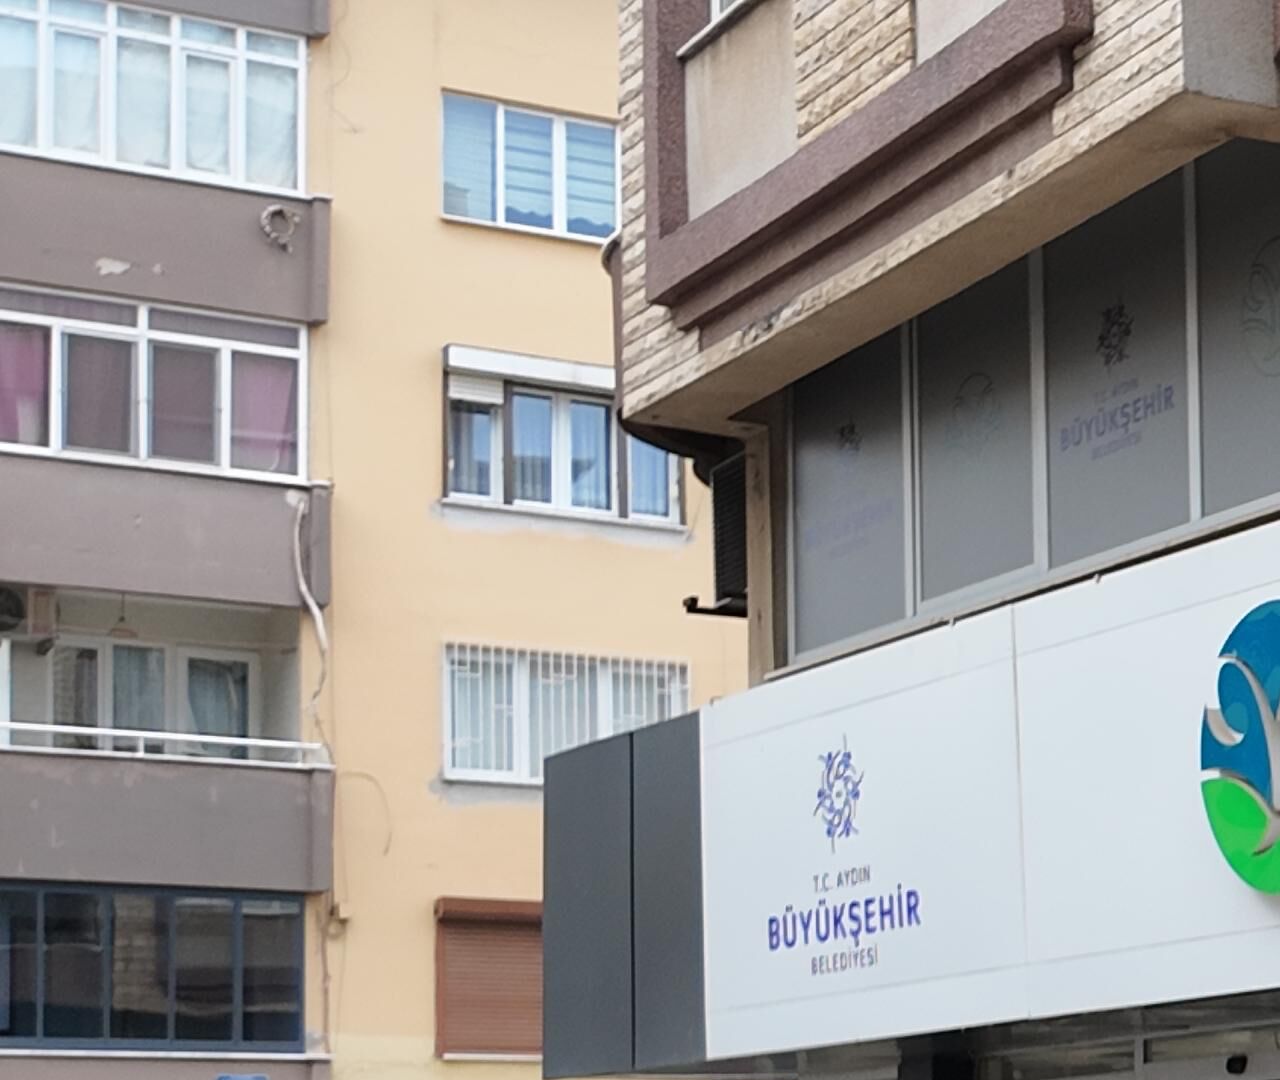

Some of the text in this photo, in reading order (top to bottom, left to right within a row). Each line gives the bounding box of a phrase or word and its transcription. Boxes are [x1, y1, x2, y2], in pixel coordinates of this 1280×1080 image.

[836, 864, 871, 888] AYDIN
[767, 883, 922, 951] BÜYÜKŞEHİR
[810, 943, 879, 976] BELEDİYESİ
